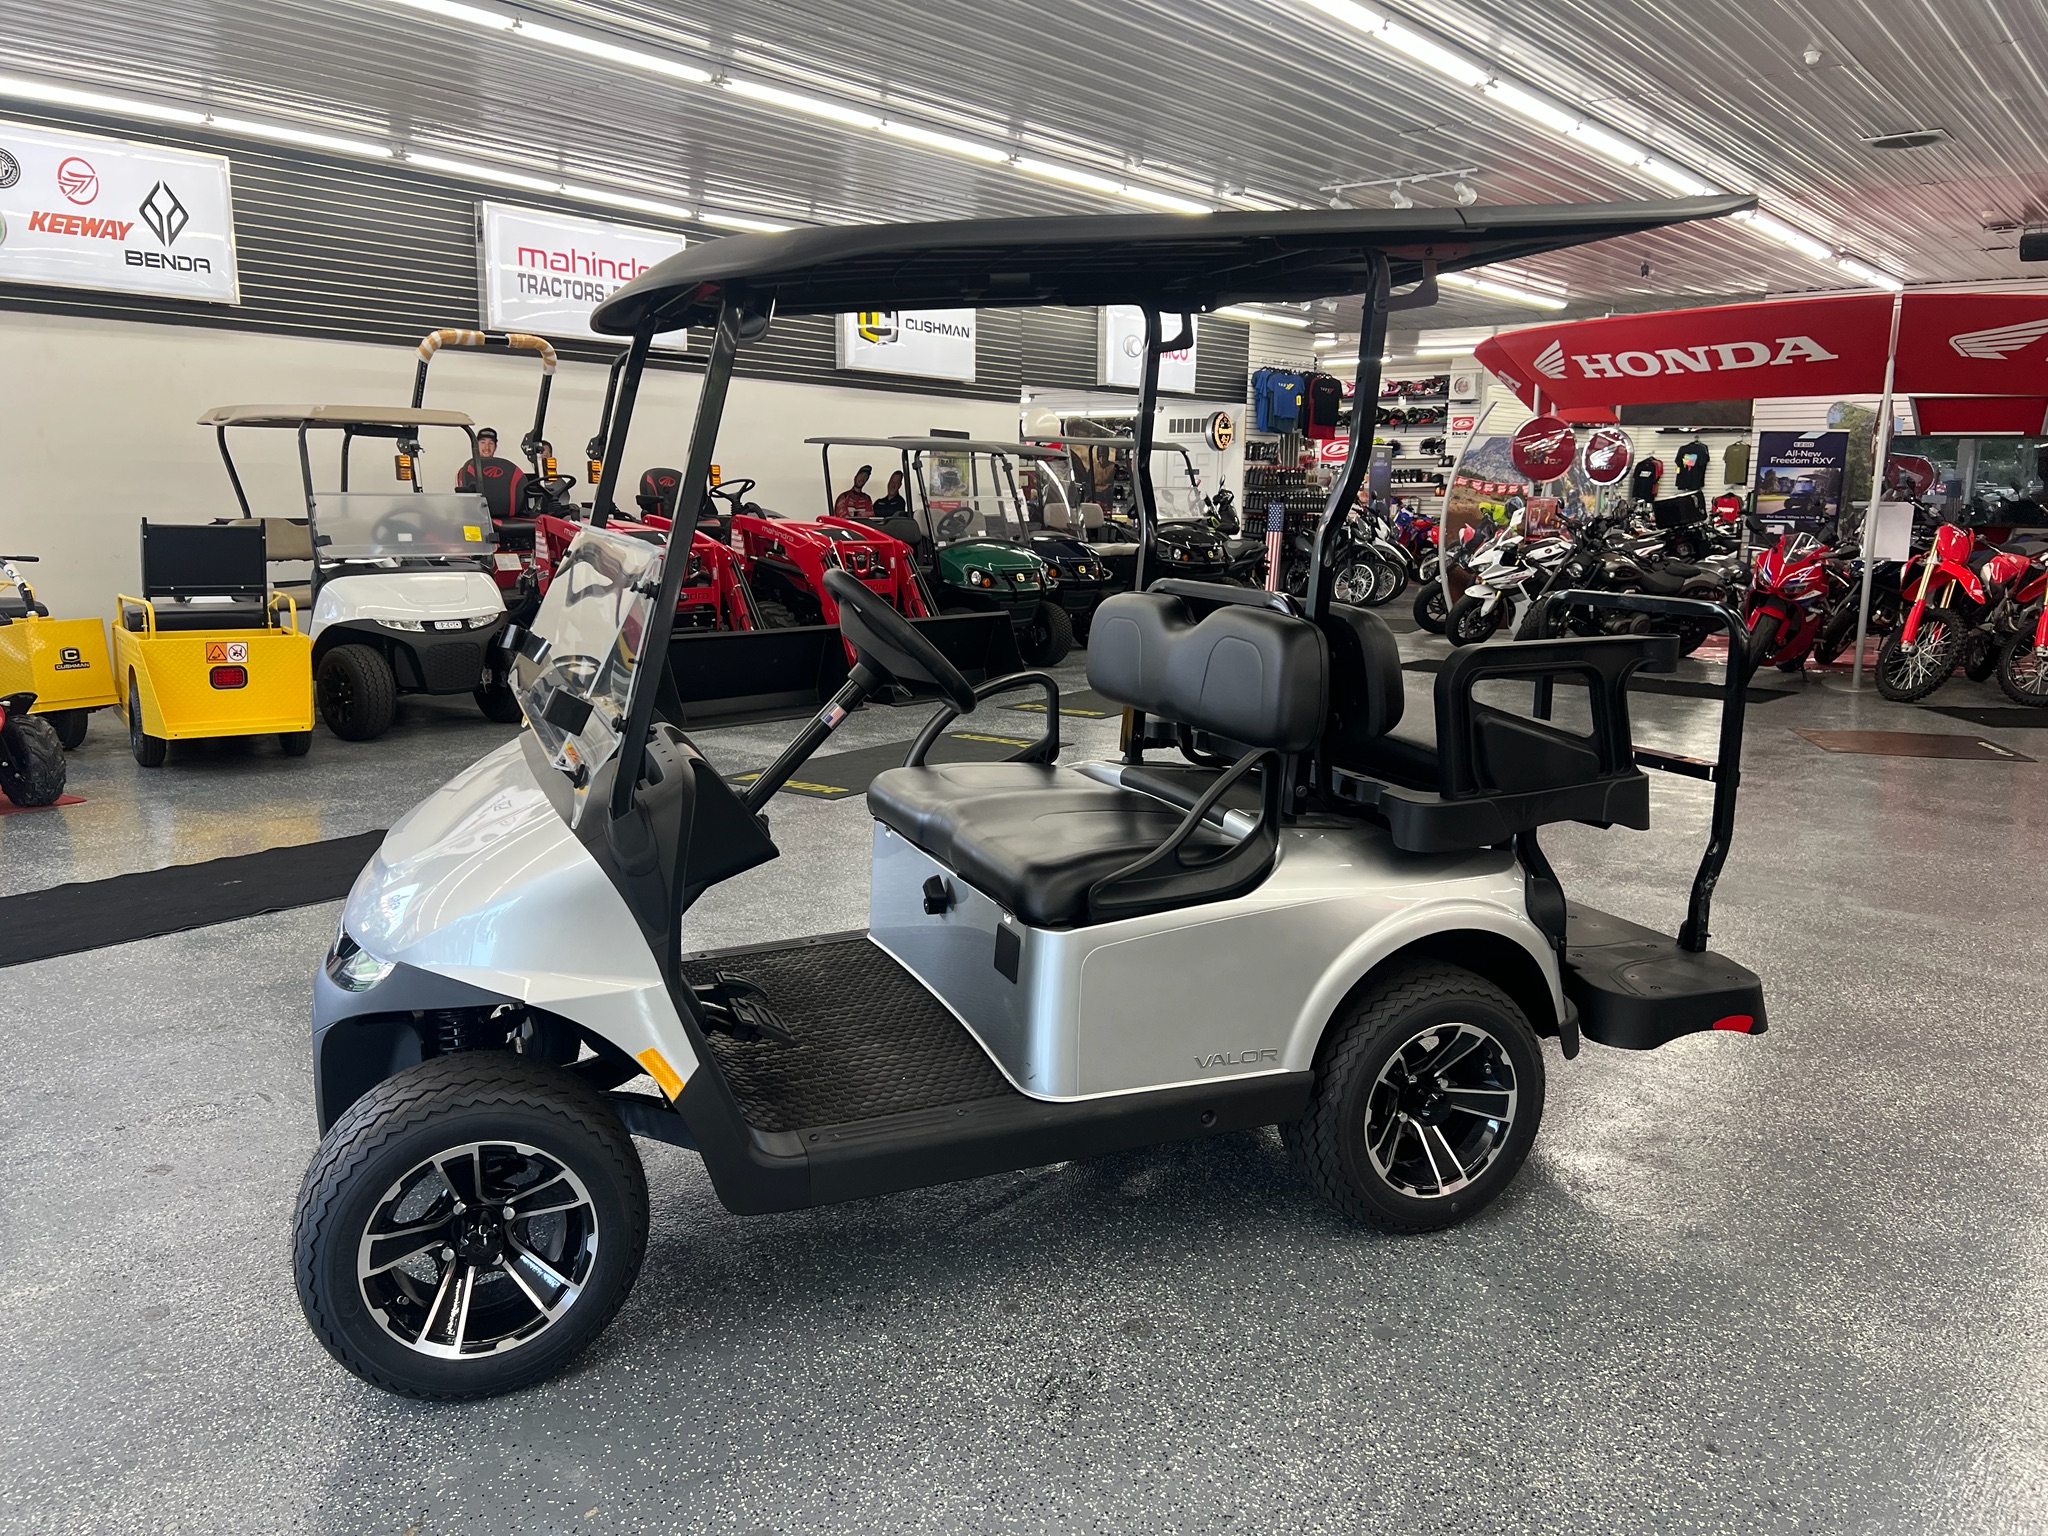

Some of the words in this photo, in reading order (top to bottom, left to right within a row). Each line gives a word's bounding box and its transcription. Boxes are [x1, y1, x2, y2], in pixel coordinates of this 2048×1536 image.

[28, 211, 134, 241] KEEWAY
[125, 250, 211, 274] BENDA
[518, 247, 650, 281] mahindr
[517, 273, 605, 303] TRACTORS
[905, 318, 970, 338] CUSHMAN
[1161, 348, 1189, 361] MCO
[1571, 336, 1839, 378] HONDA
[762, 525, 794, 542] mahindra
[1194, 1048, 1278, 1069] VALOR
